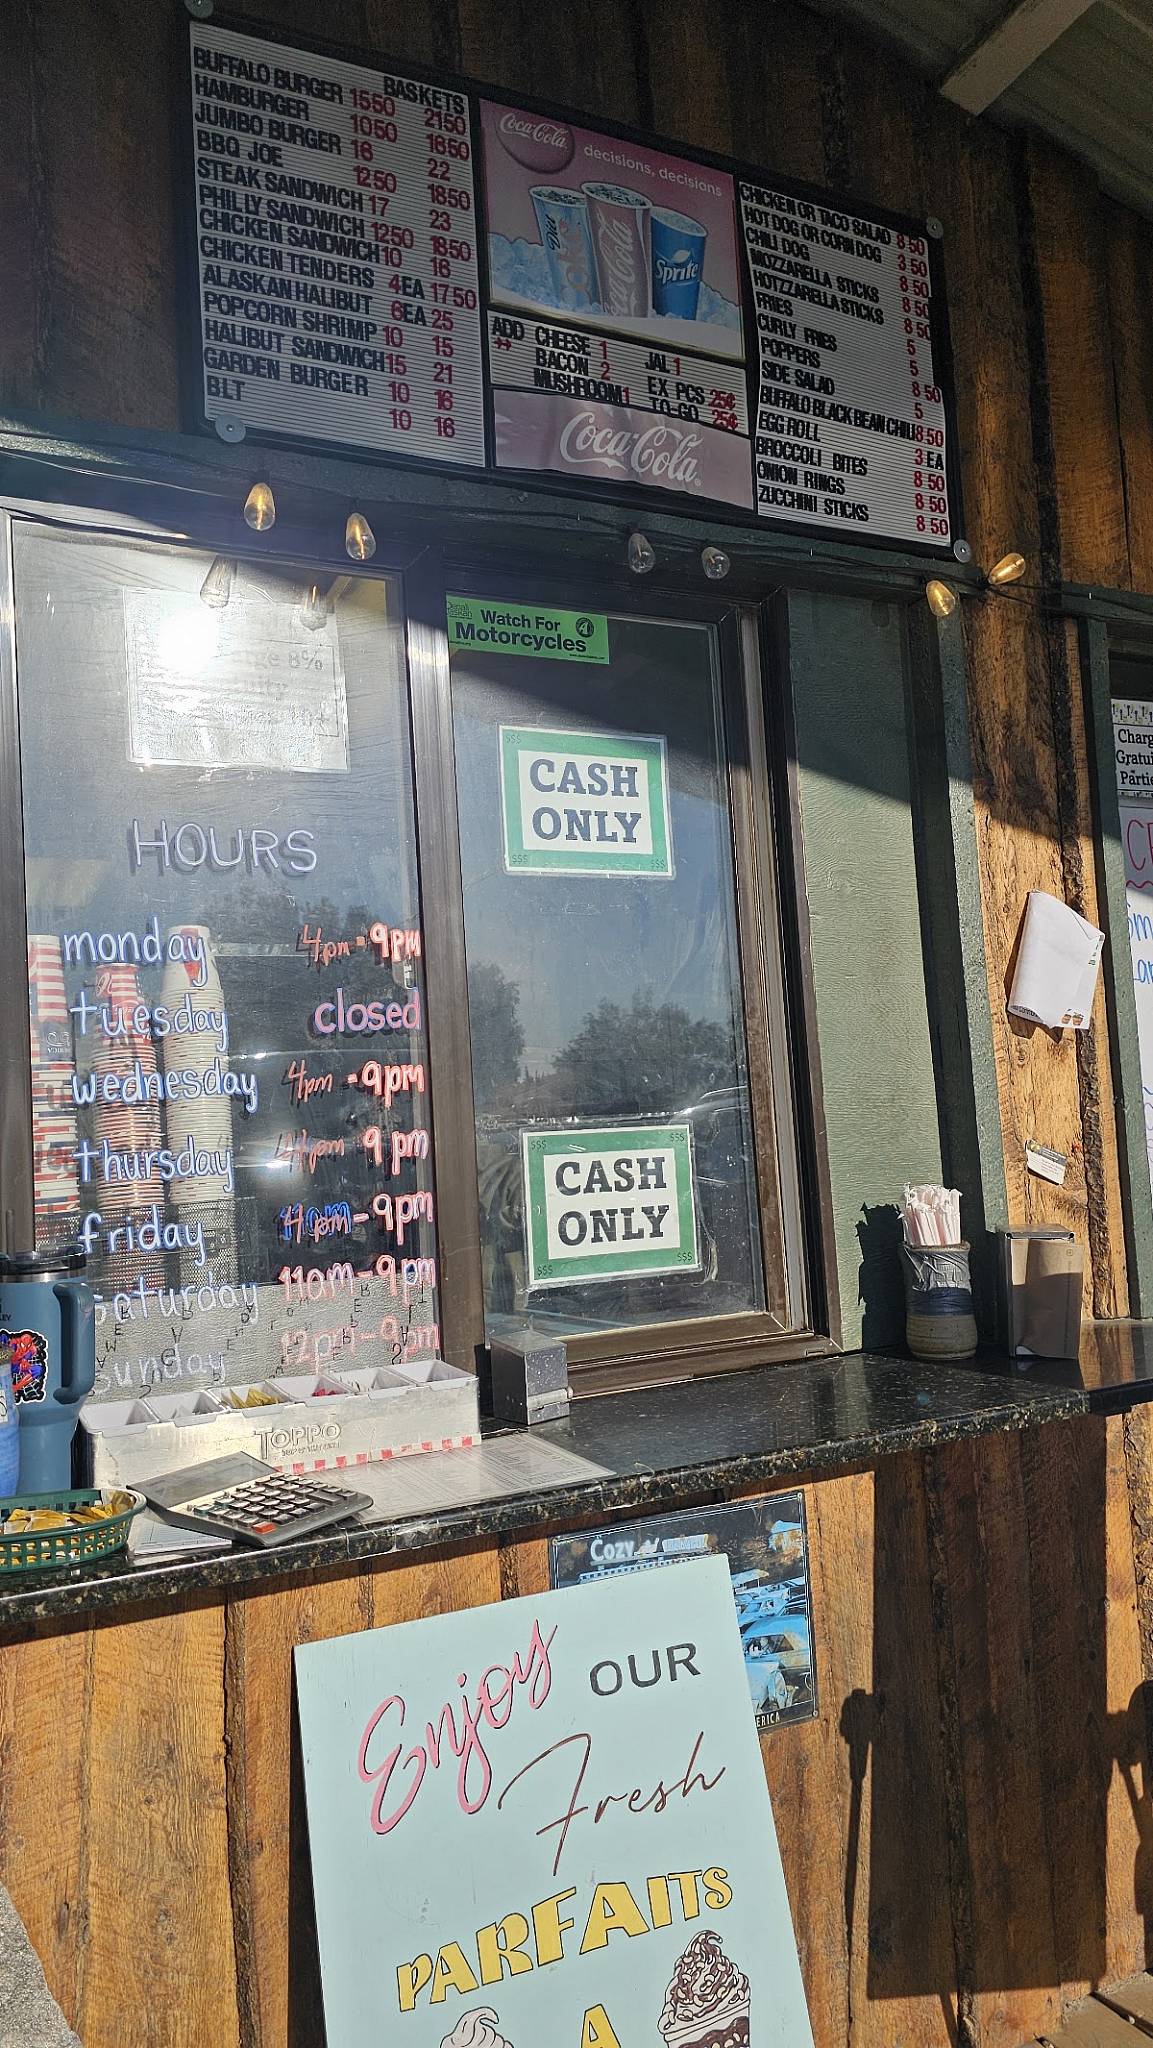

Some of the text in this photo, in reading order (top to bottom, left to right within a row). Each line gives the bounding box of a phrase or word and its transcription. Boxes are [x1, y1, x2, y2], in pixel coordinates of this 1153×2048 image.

[194, 47, 270, 84] BUFFALO
[274, 68, 344, 104] BURGER
[195, 74, 310, 121] HAMBURGER
[384, 76, 464, 115] BASKETS
[195, 103, 450, 181] JUMBO BURGER 16 22
[197, 129, 240, 158] BBQ
[248, 141, 283, 167] JOE
[500, 113, 568, 149] Coca-Cola
[198, 157, 451, 232] STEAK SANDWICH 17 23
[584, 144, 723, 198] decisions, decisions
[200, 185, 262, 216] PHILLY
[266, 199, 365, 240] SANDWICH
[200, 209, 283, 244] CHICKEN
[287, 226, 380, 264] SANDWICH
[382, 246, 402, 268] 10
[741, 184, 796, 216] CHICKEN
[800, 202, 816, 222] OR
[818, 208, 850, 232] TACO
[852, 218, 891, 246] SALAD
[909, 237, 925, 256] 50
[744, 204, 927, 277] HOT DOG OR CORN DOG 50
[200, 235, 375, 288] CHICKEN TENDERS
[655, 257, 699, 285] Sprite
[746, 227, 929, 299] CHILI DOG 8 50
[203, 264, 454, 331] ALASKAN HALIBUT 25
[837, 276, 879, 304] STICKS
[902, 297, 911, 314] 8
[841, 298, 884, 325] STICKS
[904, 318, 913, 334] 8
[204, 291, 454, 358] POPCORN SHRIMP 10 15
[204, 318, 454, 384] HALIBUT SANDWICH 15 21
[493, 316, 608, 360] ADD CHEESE 1
[756, 291, 916, 356] FRIES 5
[757, 312, 918, 377] CURLY FRIES 5
[204, 347, 280, 381] GARDEN
[290, 363, 369, 396] BURGER
[388, 381, 410, 403] 10
[534, 368, 622, 405] MUSHROOM
[648, 376, 669, 398] EX
[676, 381, 705, 404] PCS
[536, 347, 680, 380] BACON 2 JAL 1
[760, 336, 941, 404] POPPERS 8 50
[761, 360, 924, 420] SIDE SALAD 5
[207, 375, 455, 438] BLT 10 16
[651, 398, 700, 421] TO-GO
[760, 384, 944, 448] BUFFALO BLACK BEAN CHILI 8 50
[559, 411, 703, 485] Coca-Cola
[756, 436, 945, 492] BROCCOLI BITES 8 50
[759, 410, 944, 470] EGG ROLL 3 EA
[757, 460, 946, 514] ONION RINGS 8 50
[758, 485, 948, 536] ZUCCHINI STICKS 8 50
[456, 621, 586, 652] Motorcycles
[481, 609, 530, 628] Watch
[535, 616, 560, 632] For
[529, 758, 639, 798] CASH
[134, 819, 317, 872] HOURS
[532, 806, 642, 843] ONLY
[64, 917, 209, 987] monday
[69, 987, 421, 1051] tuesday closed
[71, 1056, 258, 1112] wednesday
[72, 1135, 235, 1192] thursday
[555, 1156, 666, 1196] CASH
[77, 1204, 206, 1267] friday
[558, 1204, 670, 1246] ONLY
[254, 1422, 341, 1460] TOPPO
[590, 1537, 634, 1560] Cozy
[358, 1619, 702, 1835] Enjoy OUR
[498, 1732, 726, 1876] Fresh
[396, 1866, 733, 2012] PARFAITS
